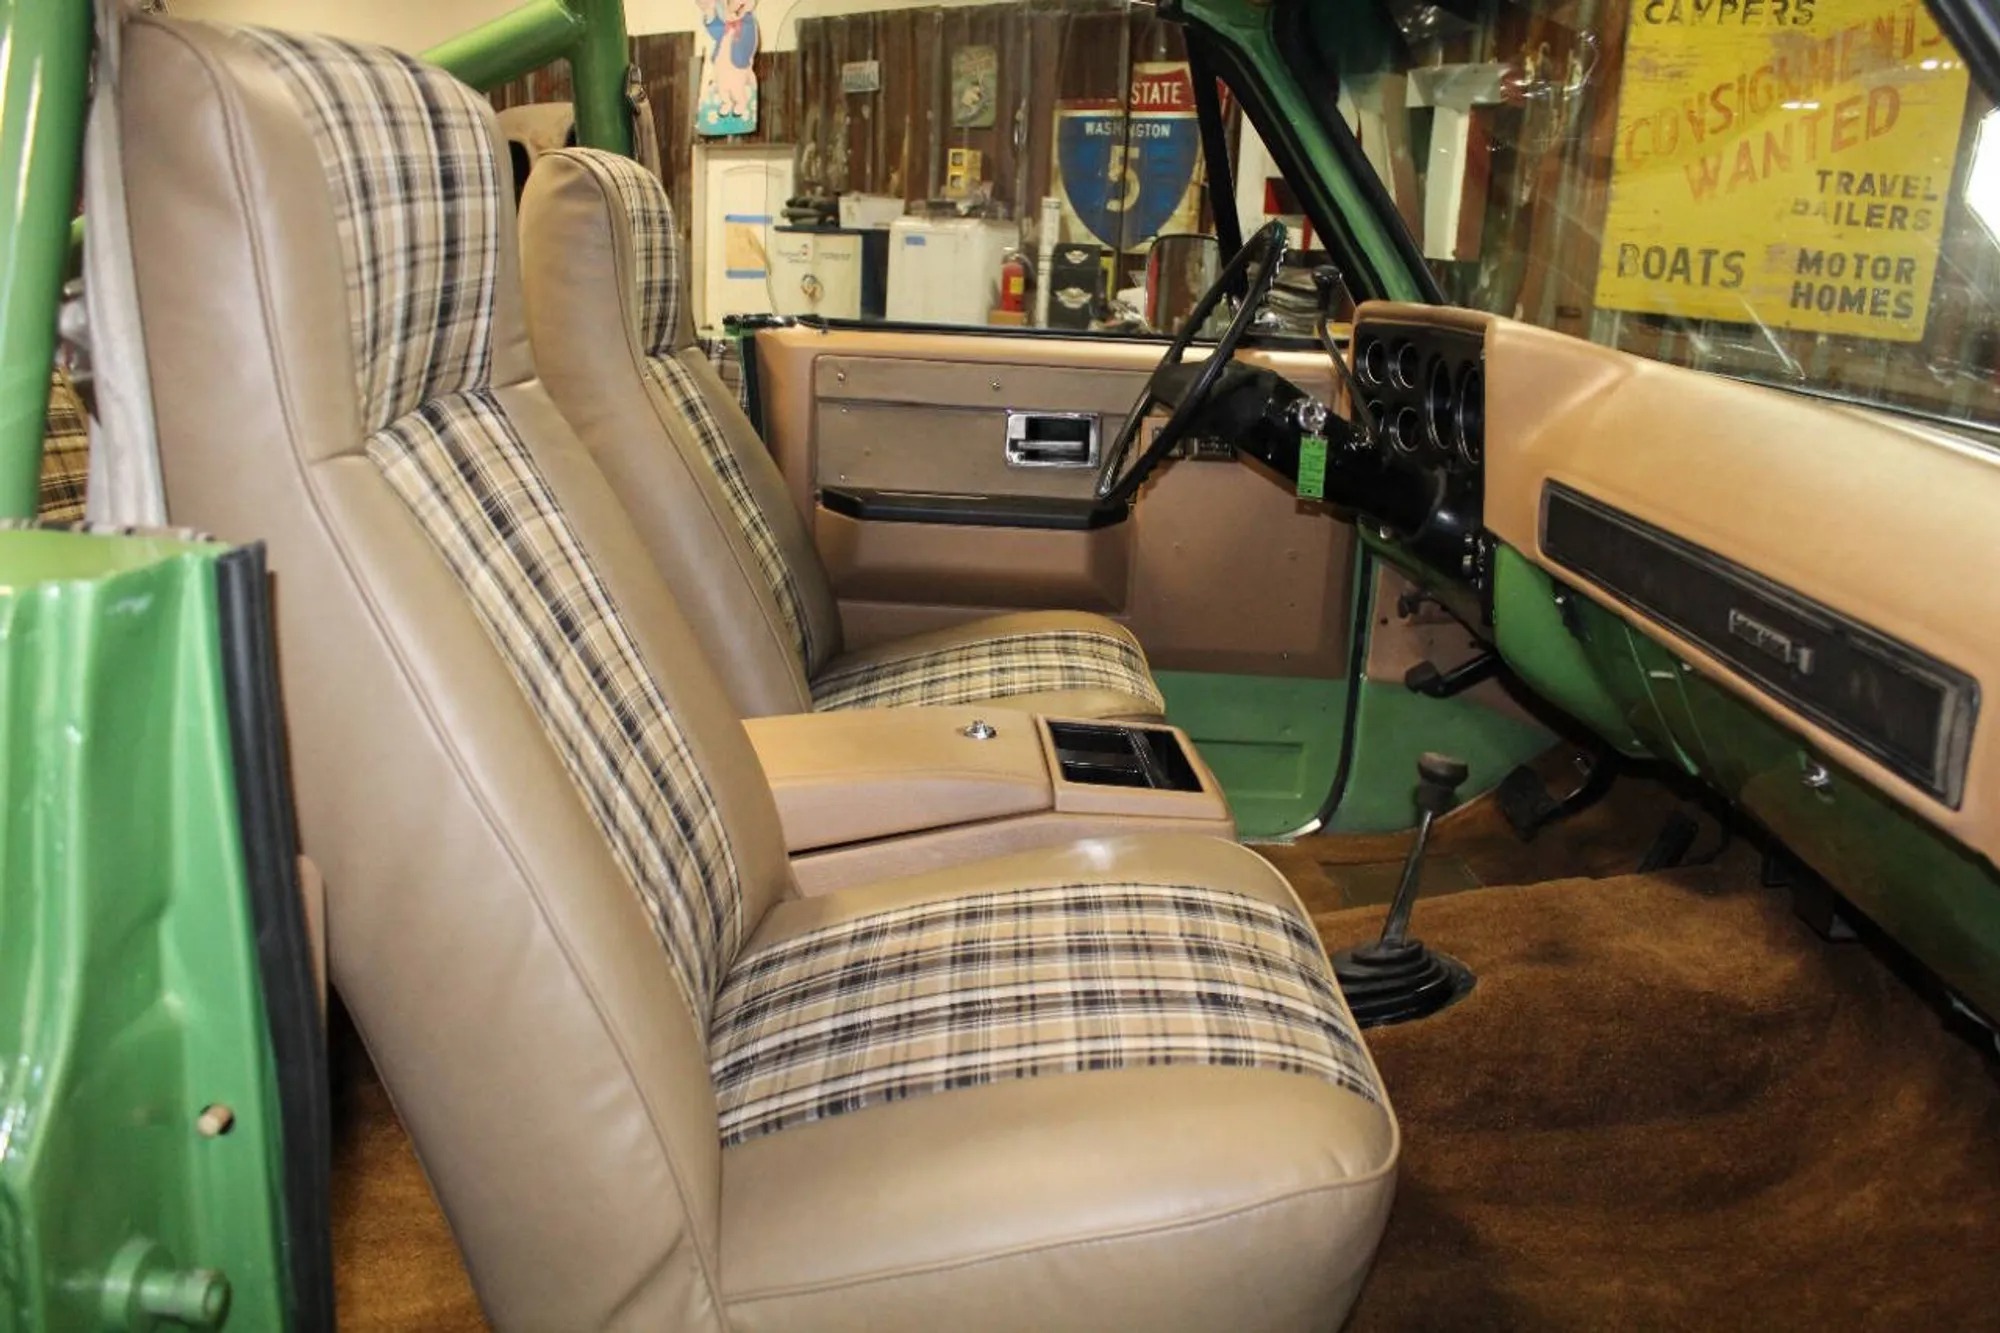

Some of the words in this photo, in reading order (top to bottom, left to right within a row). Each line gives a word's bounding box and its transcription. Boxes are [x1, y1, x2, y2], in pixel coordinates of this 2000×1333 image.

[1084, 121, 1172, 138] WASHNGTON
[1683, 85, 1900, 201] WANTED
[1106, 145, 1140, 212] 5
[1816, 170, 1938, 201] TRAVEL
[1616, 243, 1746, 288] BOATS
[1796, 247, 1916, 285] MOTOR
[1789, 280, 1914, 320] HOMES
